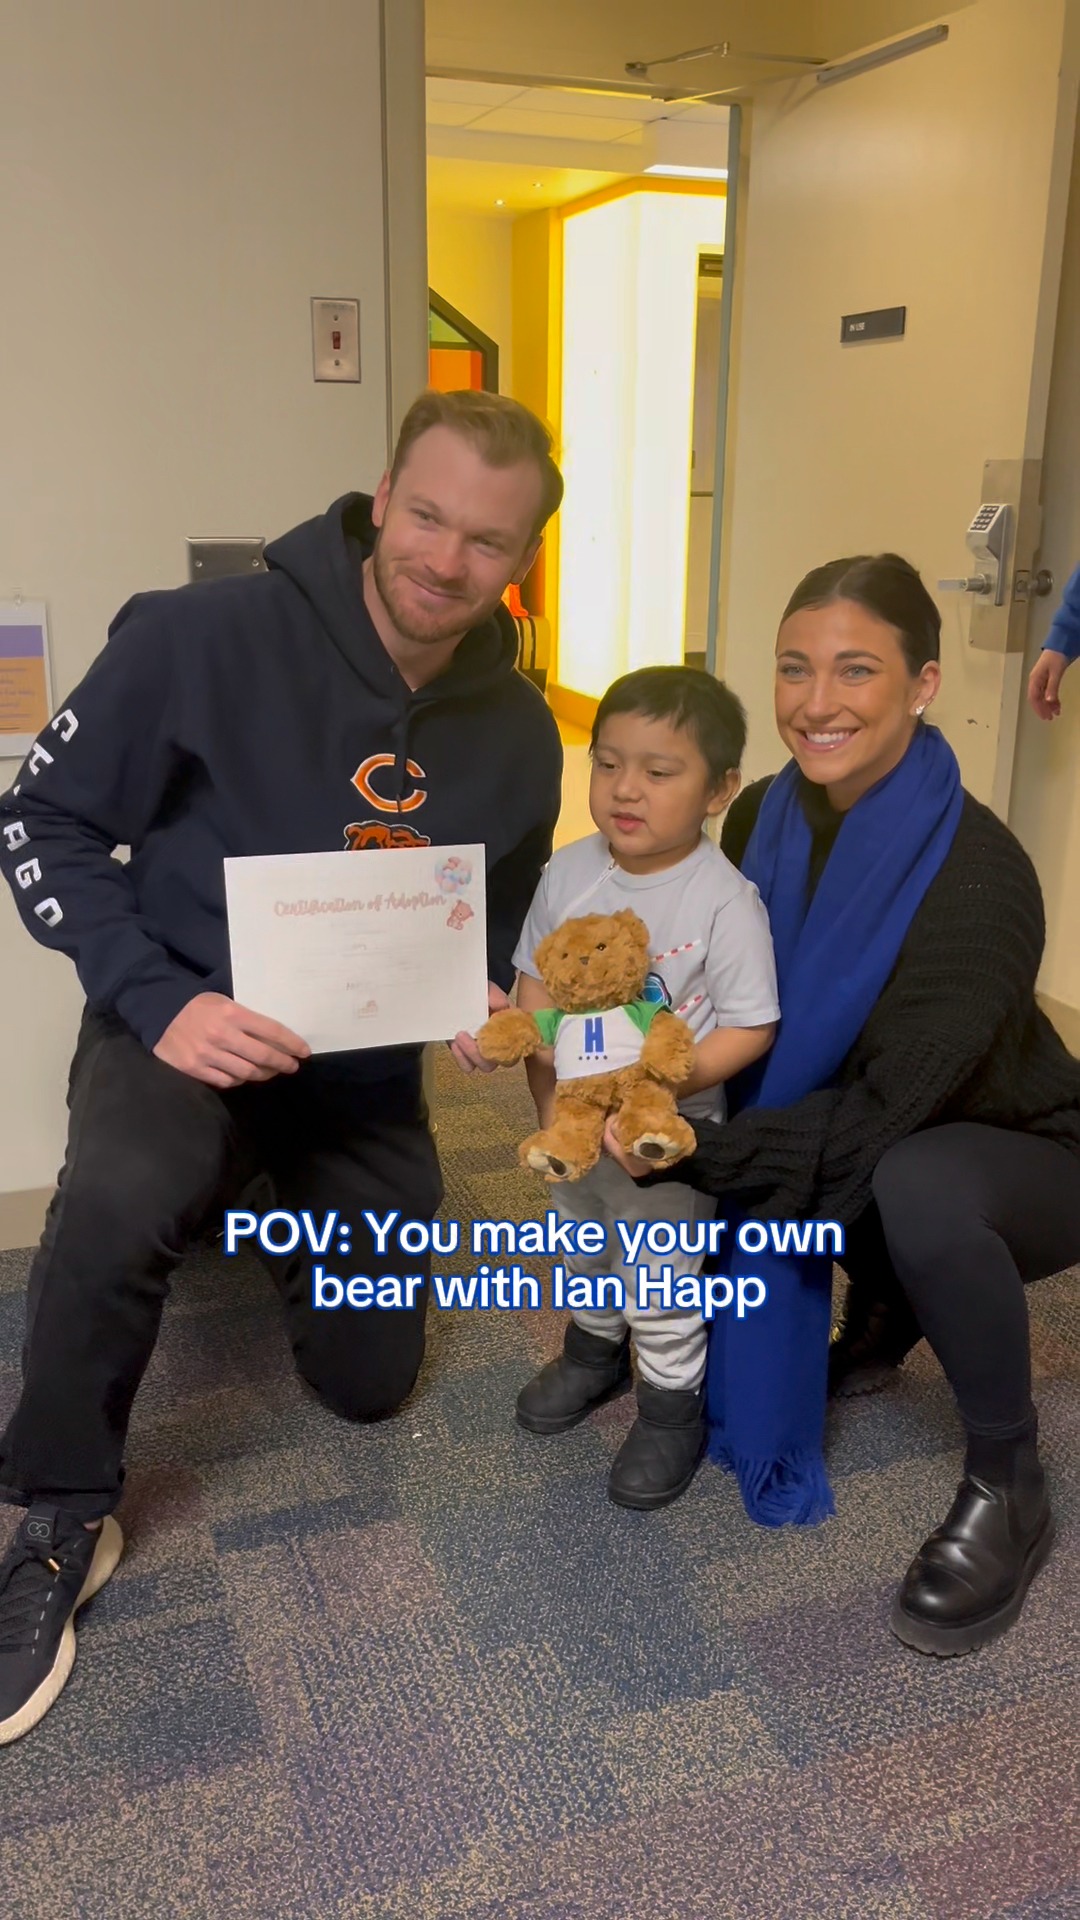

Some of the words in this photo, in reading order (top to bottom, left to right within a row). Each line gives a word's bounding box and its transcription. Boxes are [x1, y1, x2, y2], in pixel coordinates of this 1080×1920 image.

[350, 753, 428, 812] C
[3, 708, 80, 928] CHAGO
[367, 894, 383, 912] of
[384, 891, 446, 911] Adoption
[584, 1016, 605, 1053] H
